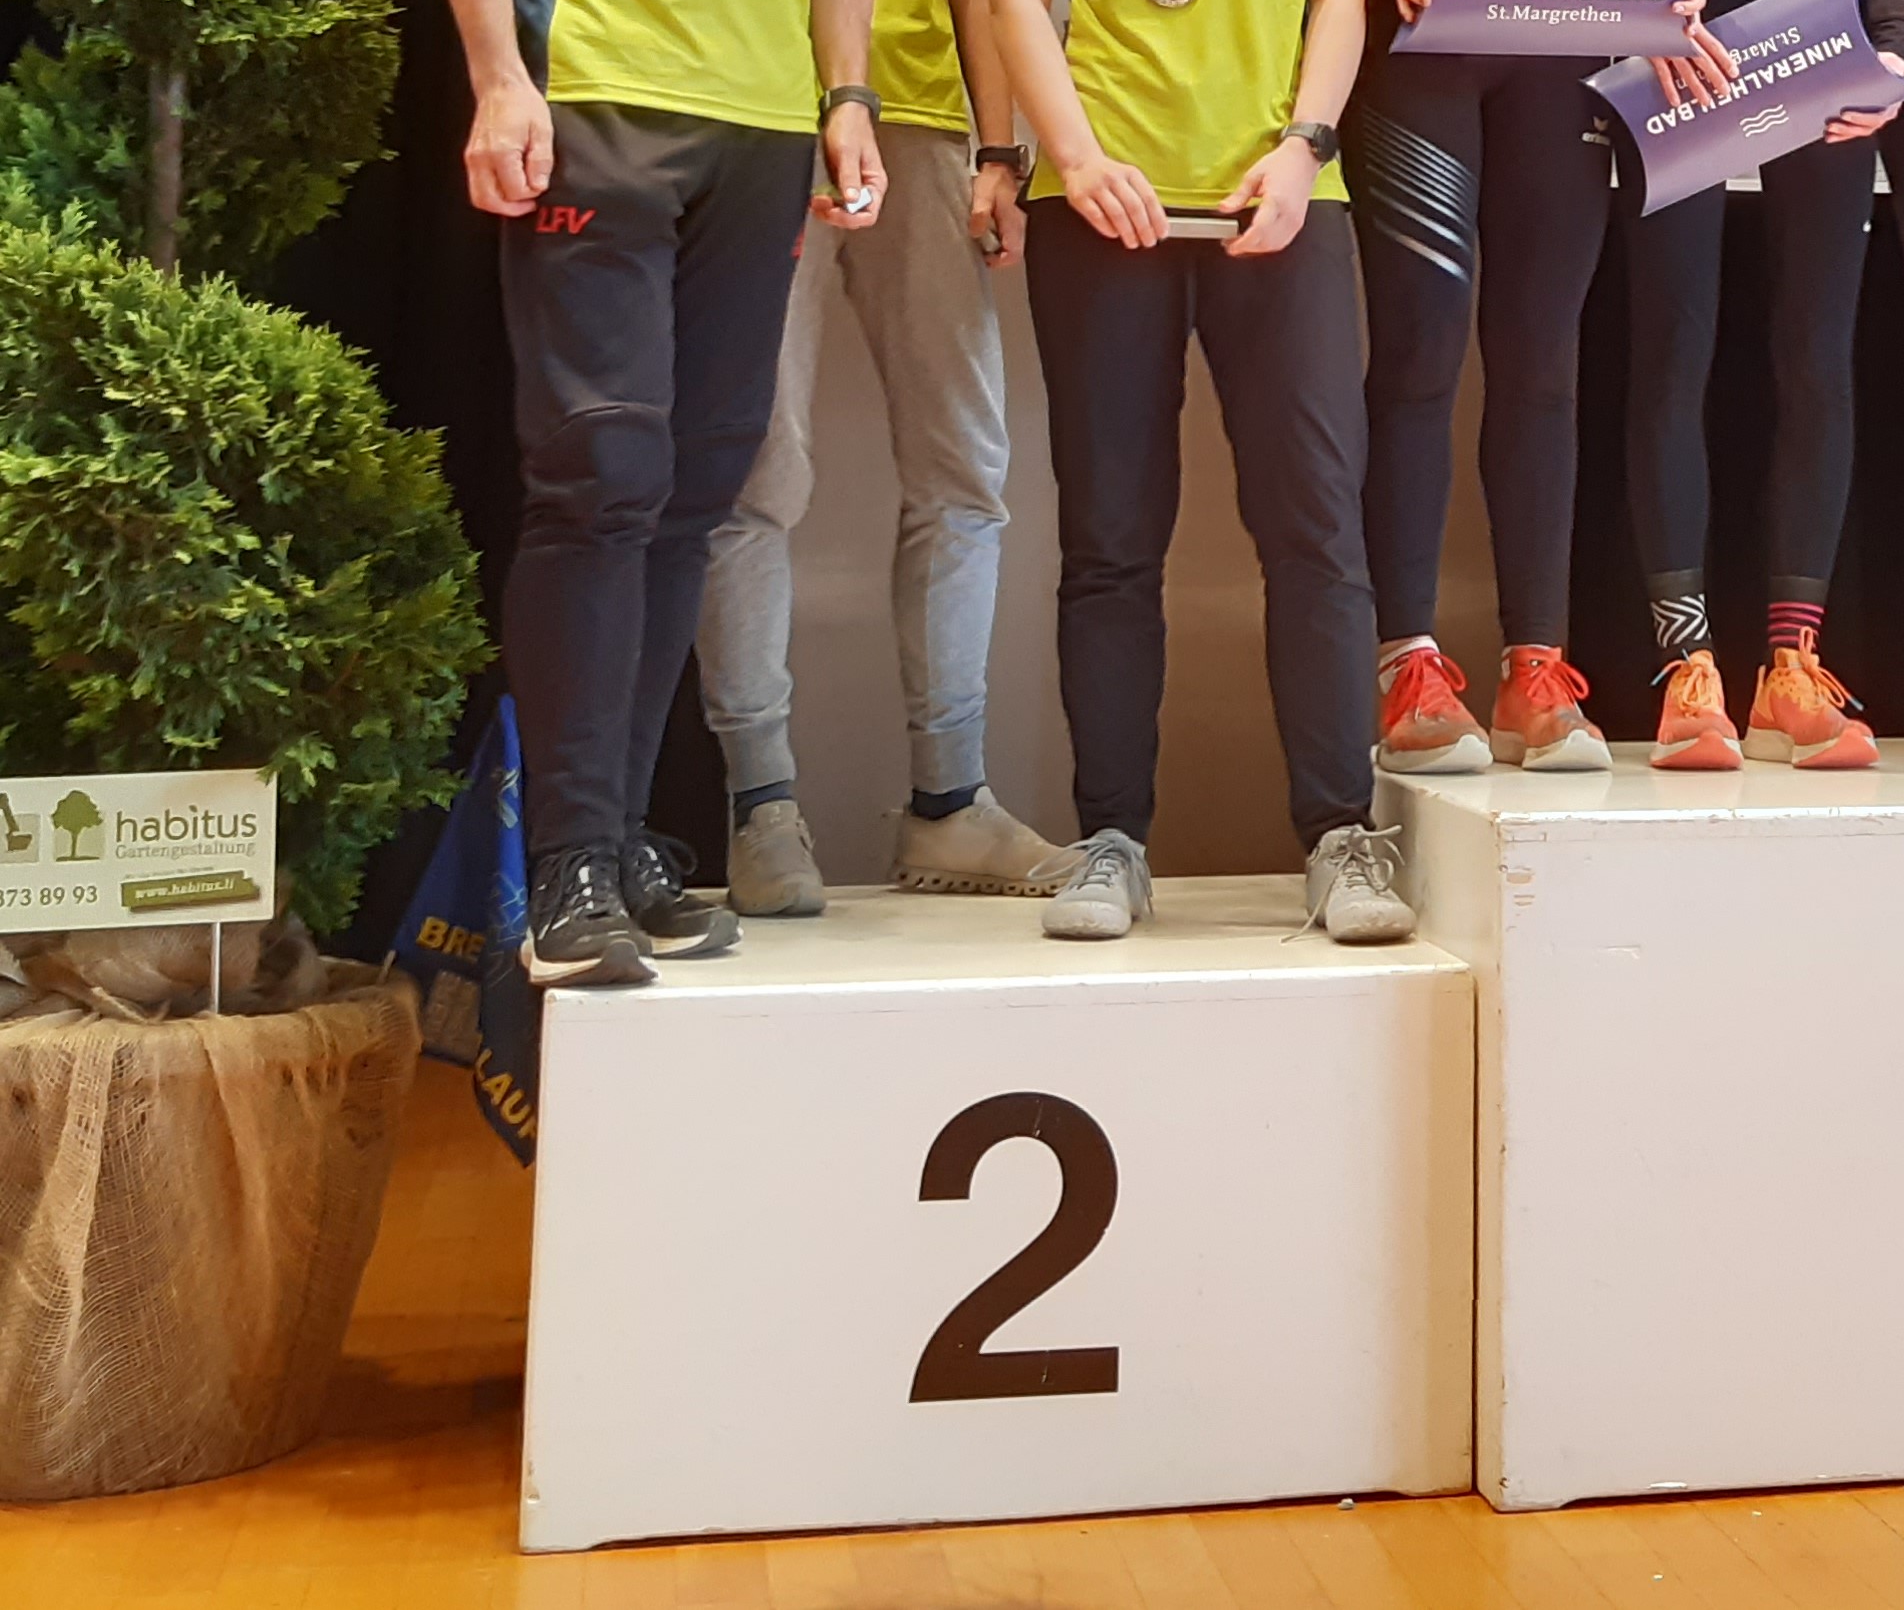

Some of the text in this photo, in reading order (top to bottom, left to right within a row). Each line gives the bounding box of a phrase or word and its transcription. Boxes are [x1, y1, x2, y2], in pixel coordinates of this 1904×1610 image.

[535, 206, 596, 234] LFV
[116, 805, 258, 843] habitus
[115, 841, 256, 860] Gartengestaltung
[40, 887, 65, 906] 89
[73, 885, 98, 904] 93
[134, 878, 235, 900] www.habitus.li
[909, 1093, 1118, 1403] 2
